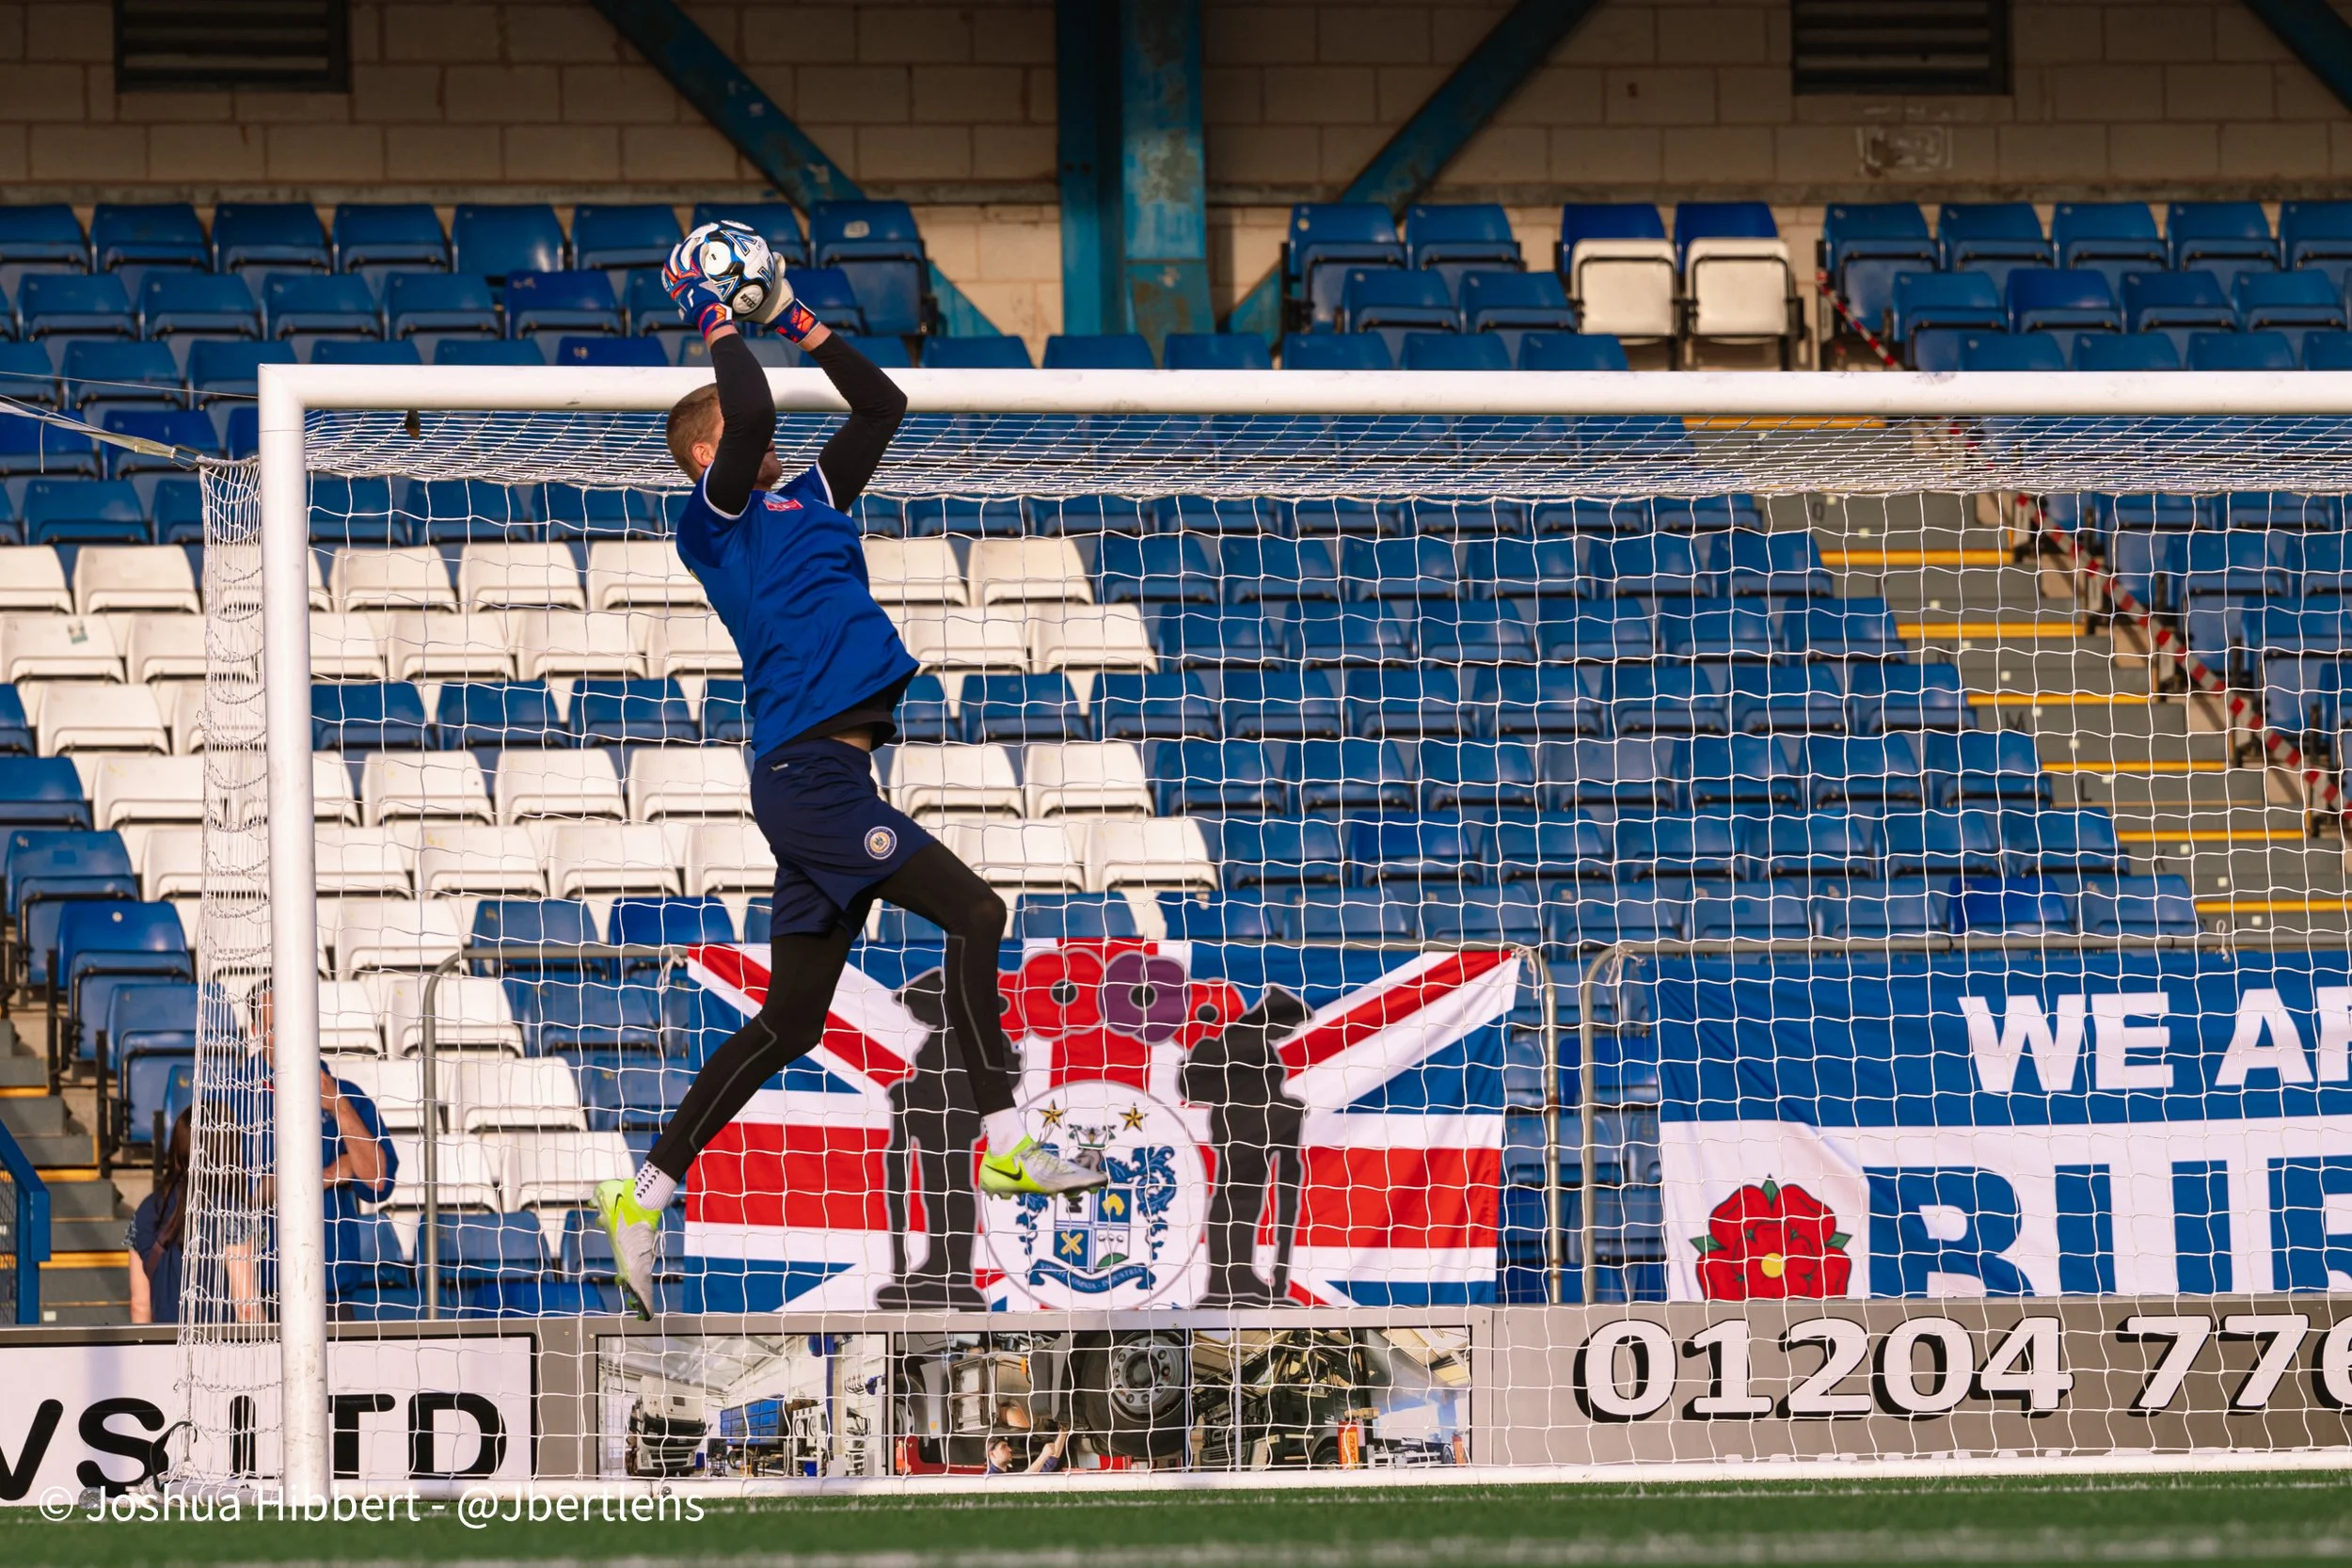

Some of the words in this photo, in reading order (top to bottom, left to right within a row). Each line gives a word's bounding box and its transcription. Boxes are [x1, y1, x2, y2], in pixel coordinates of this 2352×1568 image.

[2080, 778, 2092, 802] L
[1958, 991, 2173, 1091] WE
[1573, 1316, 2074, 1423] 01204
